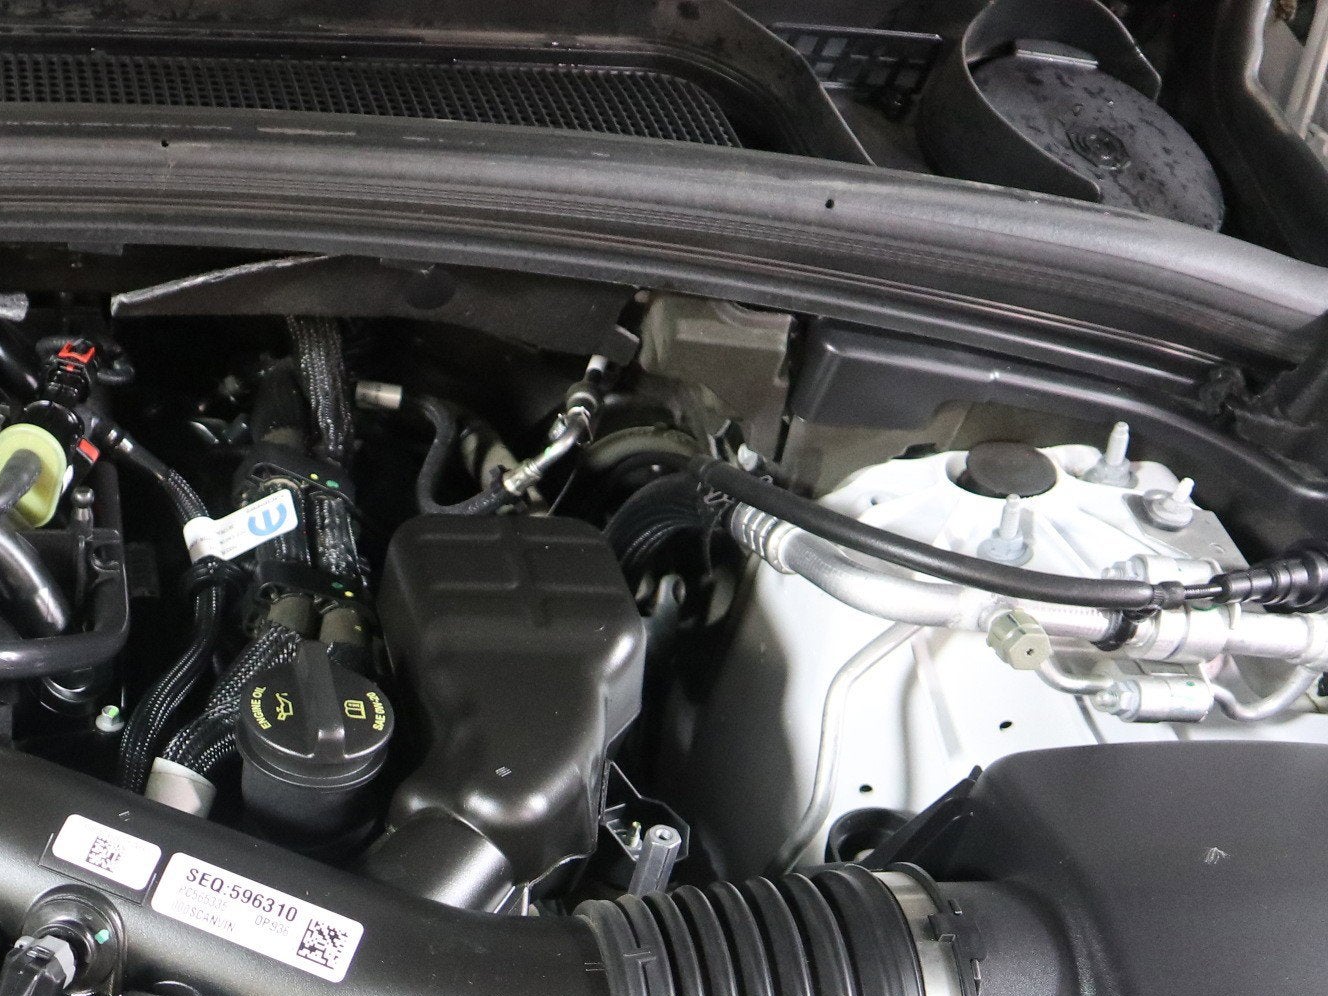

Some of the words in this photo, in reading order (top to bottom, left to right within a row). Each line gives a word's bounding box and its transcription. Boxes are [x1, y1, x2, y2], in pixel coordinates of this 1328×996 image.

[252, 686, 267, 698] OIL
[250, 698, 273, 730] ENGINE
[372, 714, 386, 731] SAE
[186, 868, 299, 922] SEQ:596310
